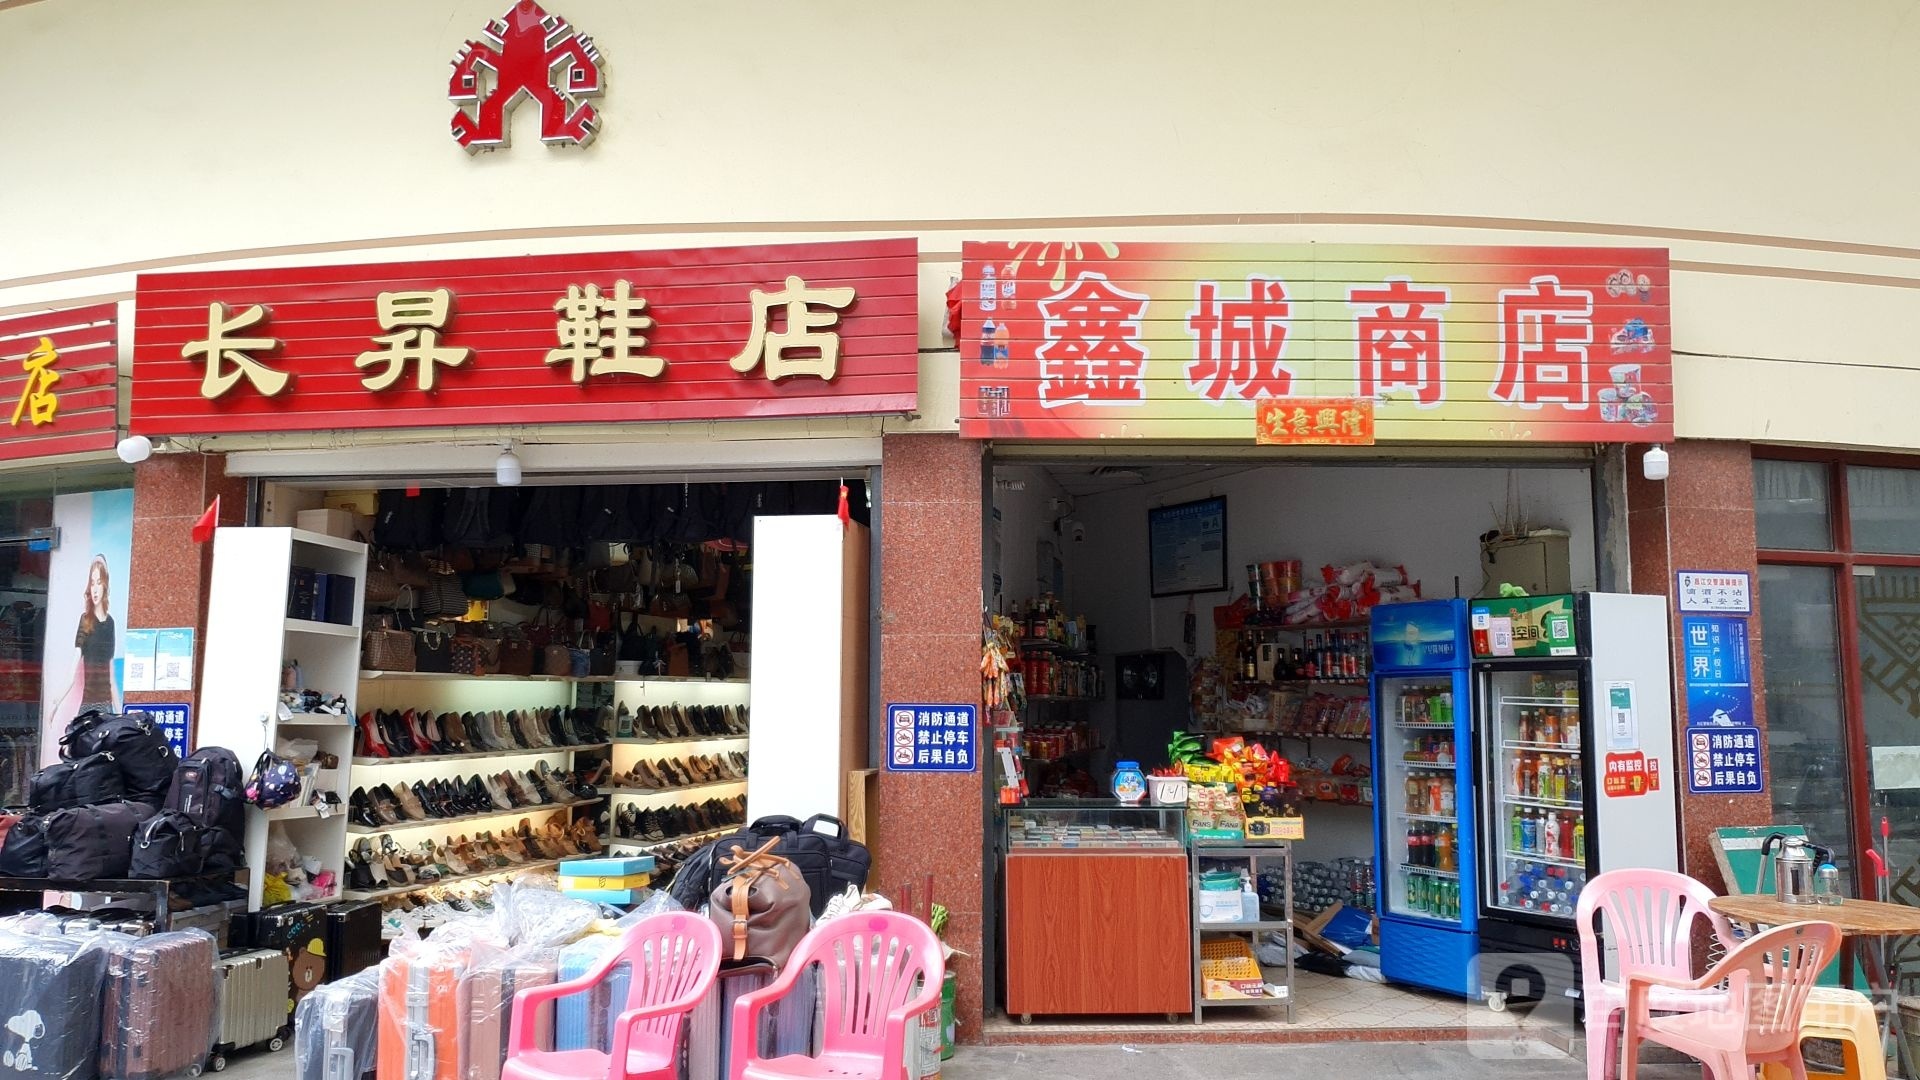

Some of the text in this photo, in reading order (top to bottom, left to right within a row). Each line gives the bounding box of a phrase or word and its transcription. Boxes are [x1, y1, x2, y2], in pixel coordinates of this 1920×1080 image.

[181, 275, 856, 399] 长昇鞋店
[1036, 273, 1592, 409] 鑫城商店
[11, 336, 60, 426] 店
[1265, 407, 1364, 436] 生意興隆
[1690, 625, 1711, 678] 世界
[147, 709, 186, 724] 防通道
[918, 711, 970, 727] 消防通道
[918, 729, 970, 745] 禁止停车
[1712, 734, 1756, 749] 消防通道
[918, 748, 969, 765] 后果自负
[1713, 752, 1757, 768] 禁止停车
[1714, 770, 1758, 786] 后果自负
